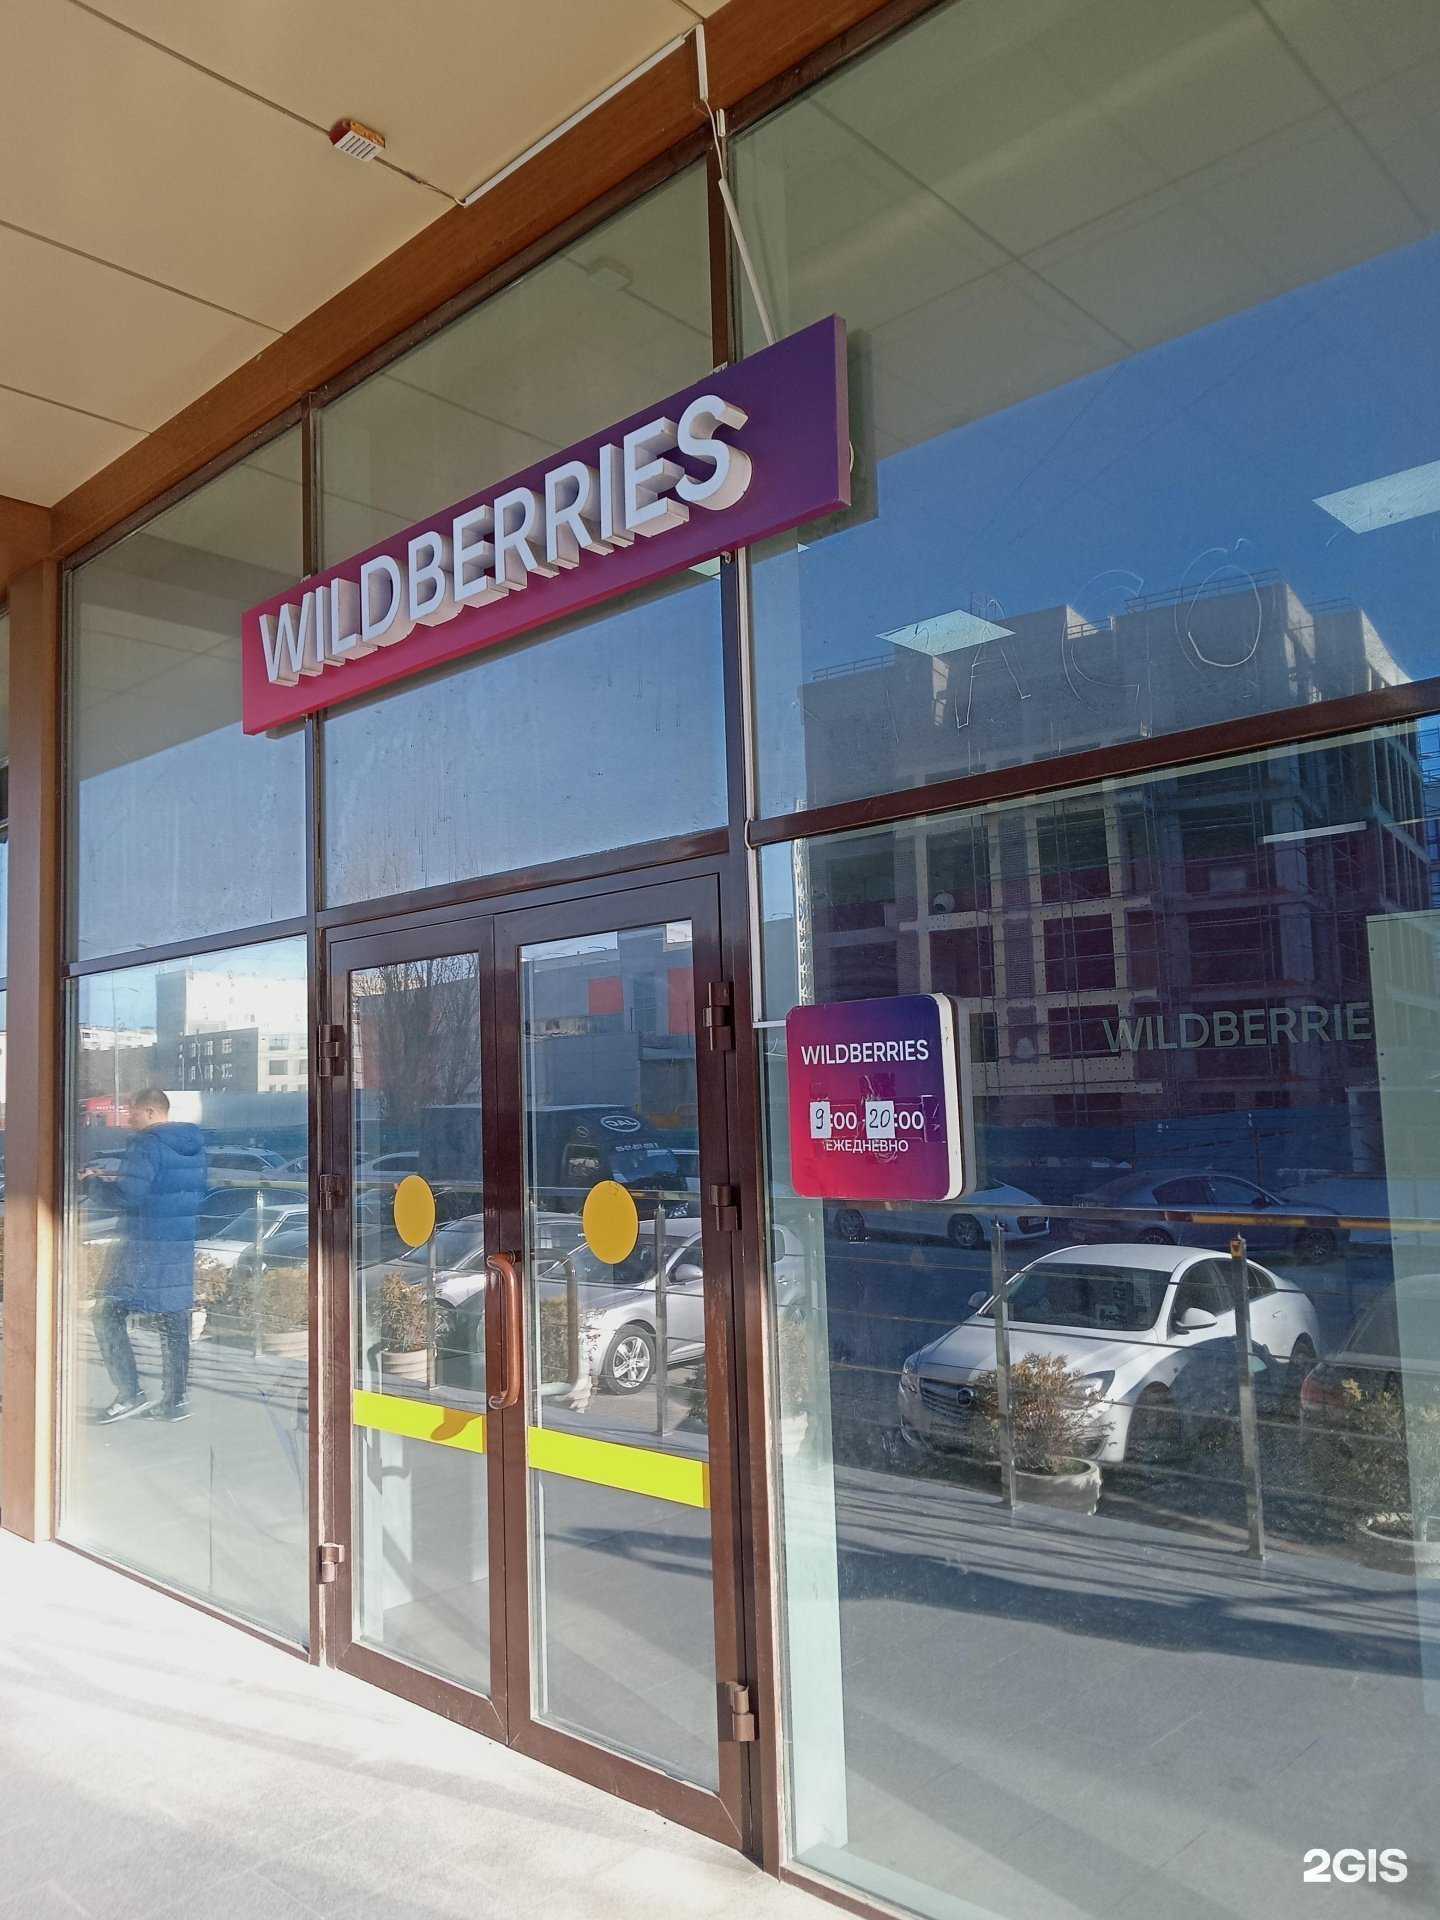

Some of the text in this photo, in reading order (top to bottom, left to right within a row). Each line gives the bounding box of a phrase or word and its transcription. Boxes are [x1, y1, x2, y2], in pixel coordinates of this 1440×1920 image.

[258, 394, 753, 687] WILDBERRIES
[800, 1039, 929, 1065] WILDBERRIES
[868, 1108, 925, 1130] 20:00
[825, 1138, 909, 1154] ЕЖЕДНЕВНО
